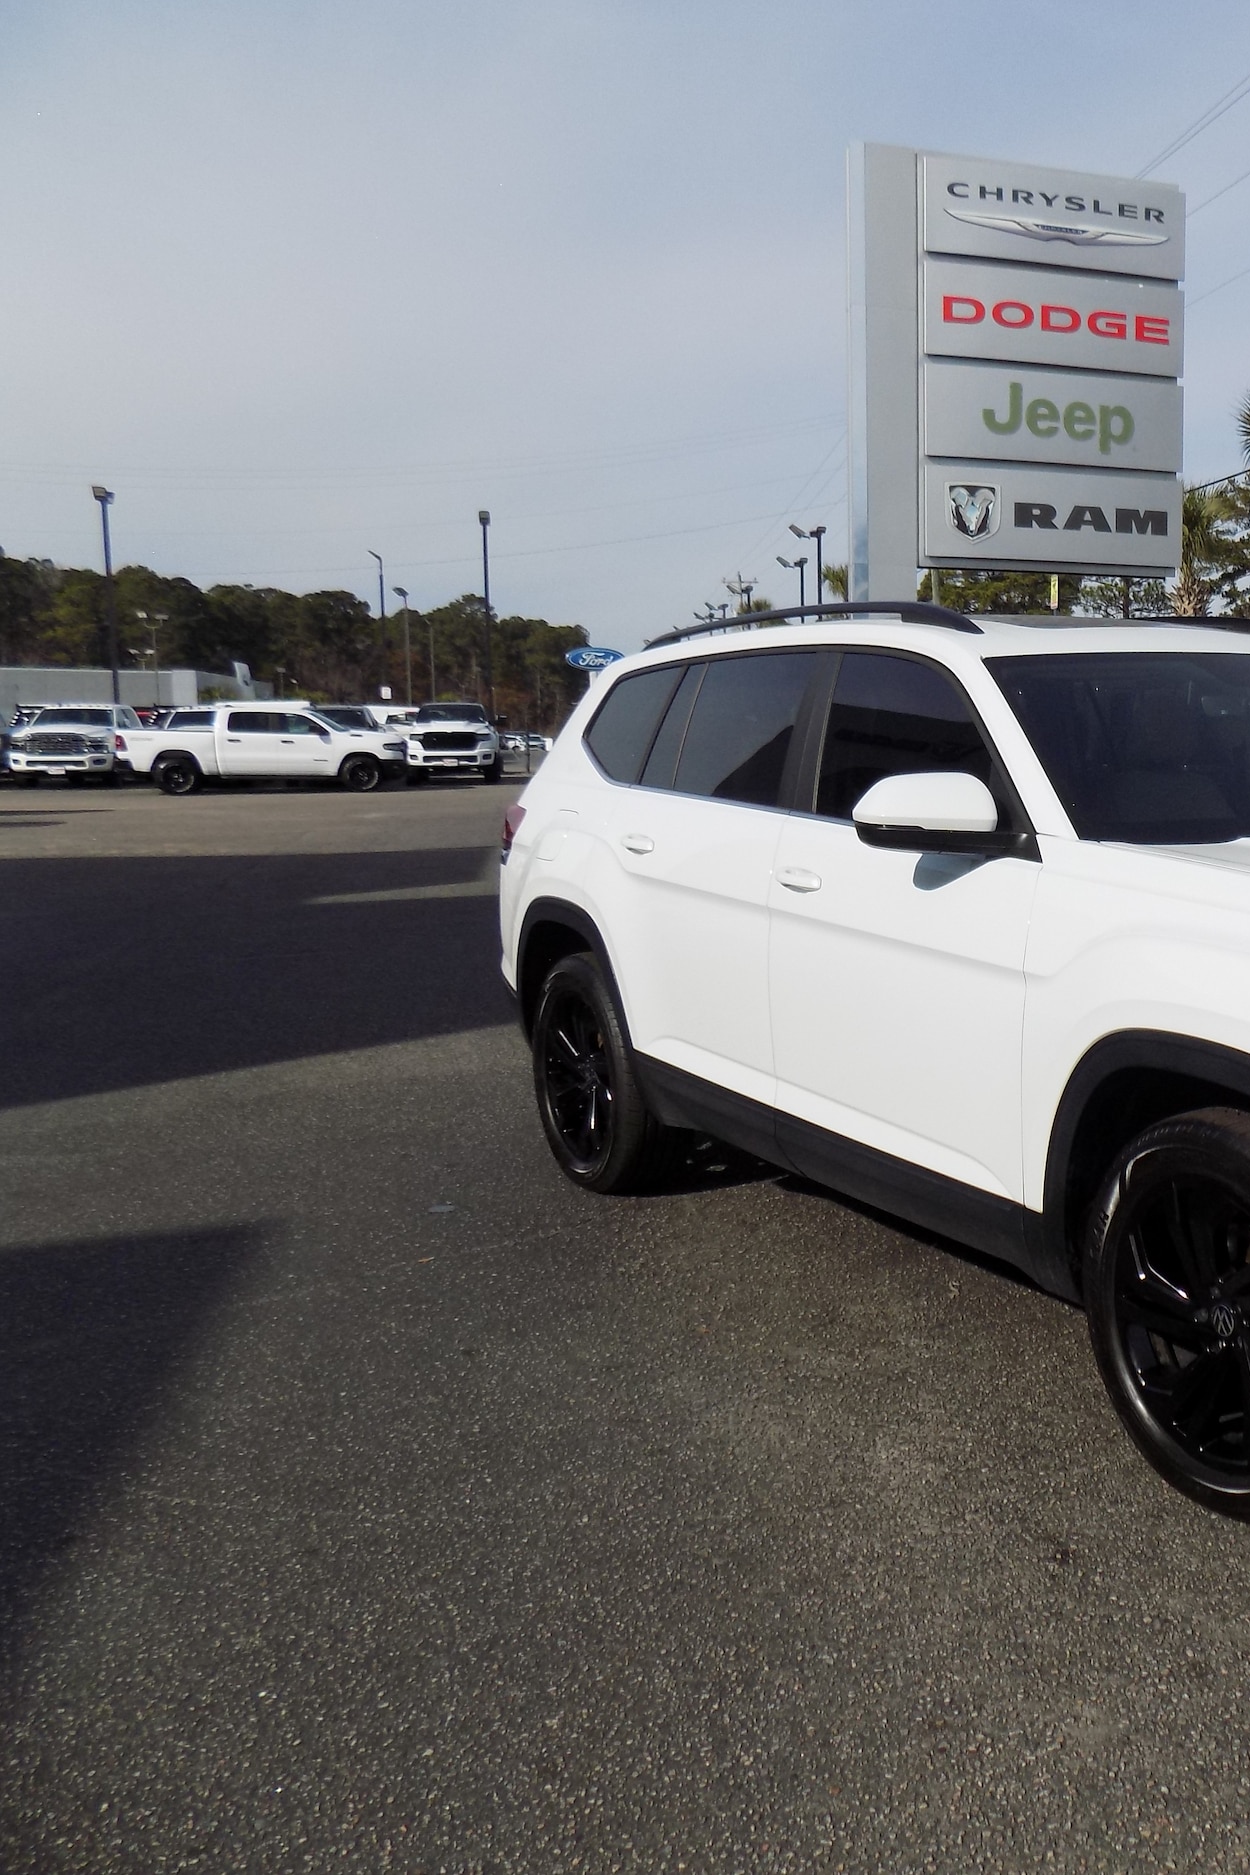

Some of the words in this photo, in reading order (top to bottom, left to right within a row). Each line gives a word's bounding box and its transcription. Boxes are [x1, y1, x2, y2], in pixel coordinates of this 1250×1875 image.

[946, 182, 1165, 224] CHRYSLER
[942, 295, 1171, 346] DODGE
[981, 381, 1136, 455] Jeep
[1013, 501, 1169, 537] RAM
[578, 651, 614, 667] Ford
